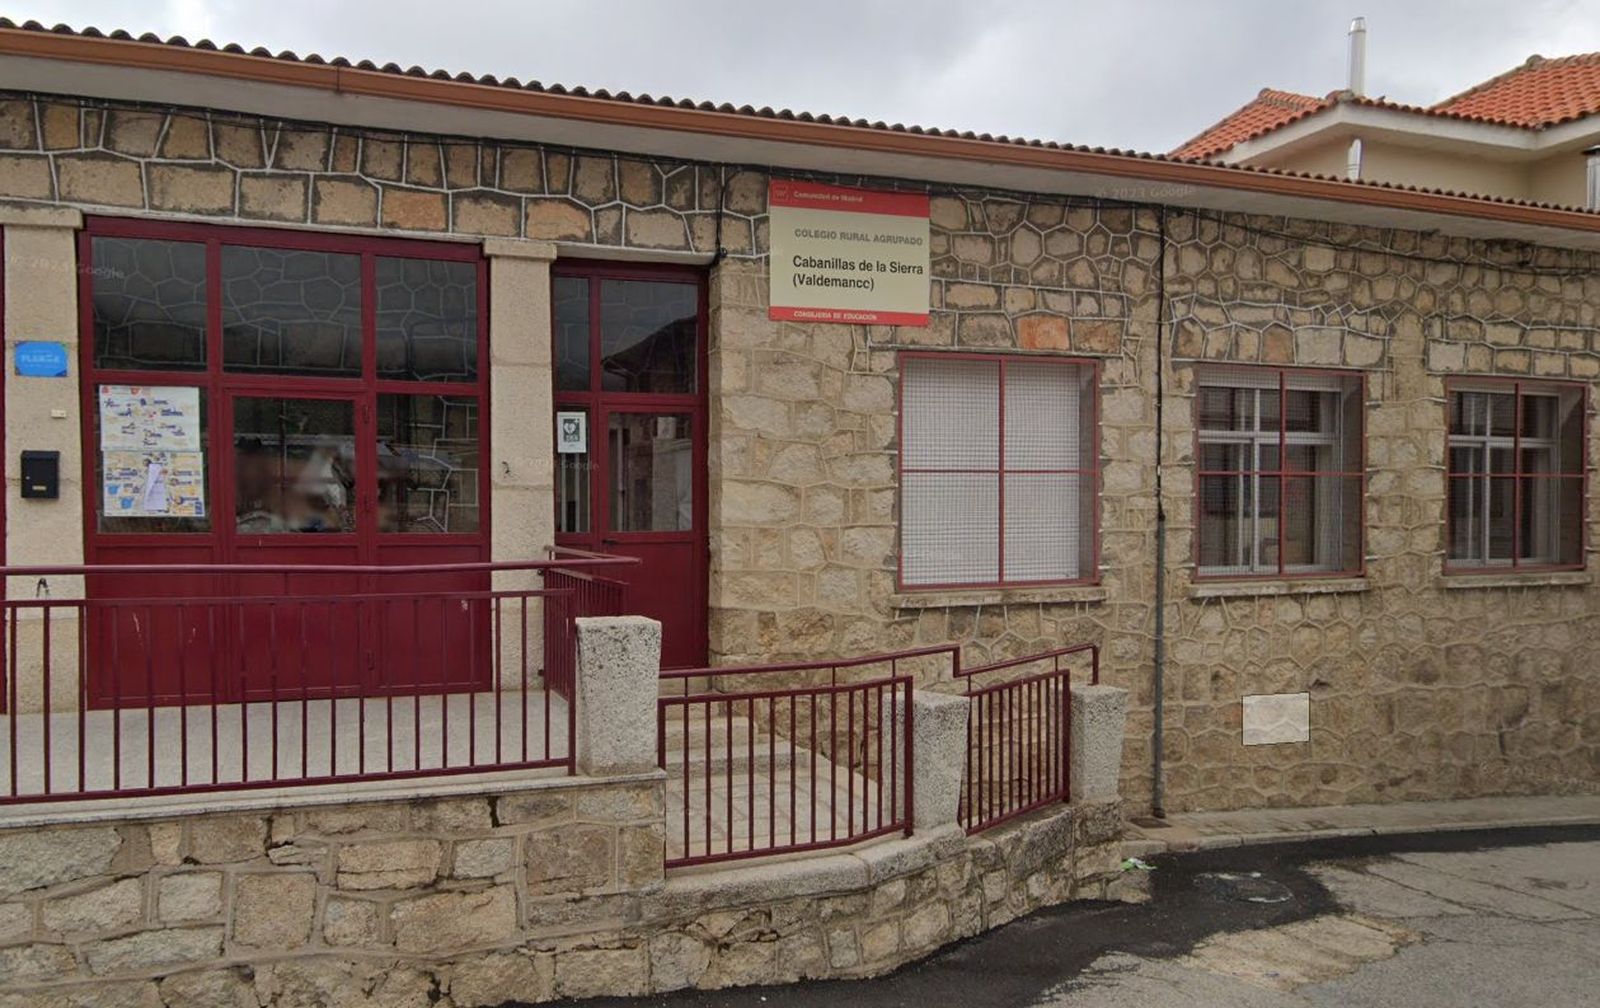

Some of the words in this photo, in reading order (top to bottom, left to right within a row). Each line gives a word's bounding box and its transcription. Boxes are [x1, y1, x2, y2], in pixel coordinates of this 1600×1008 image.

[794, 229, 838, 240] COLEGIO
[839, 232, 871, 242] RURAL
[873, 235, 924, 246] AGRUPADO
[793, 255, 856, 271] Cabanillas
[858, 260, 873, 272] de
[876, 261, 887, 273] la
[889, 261, 924, 275] Sierra
